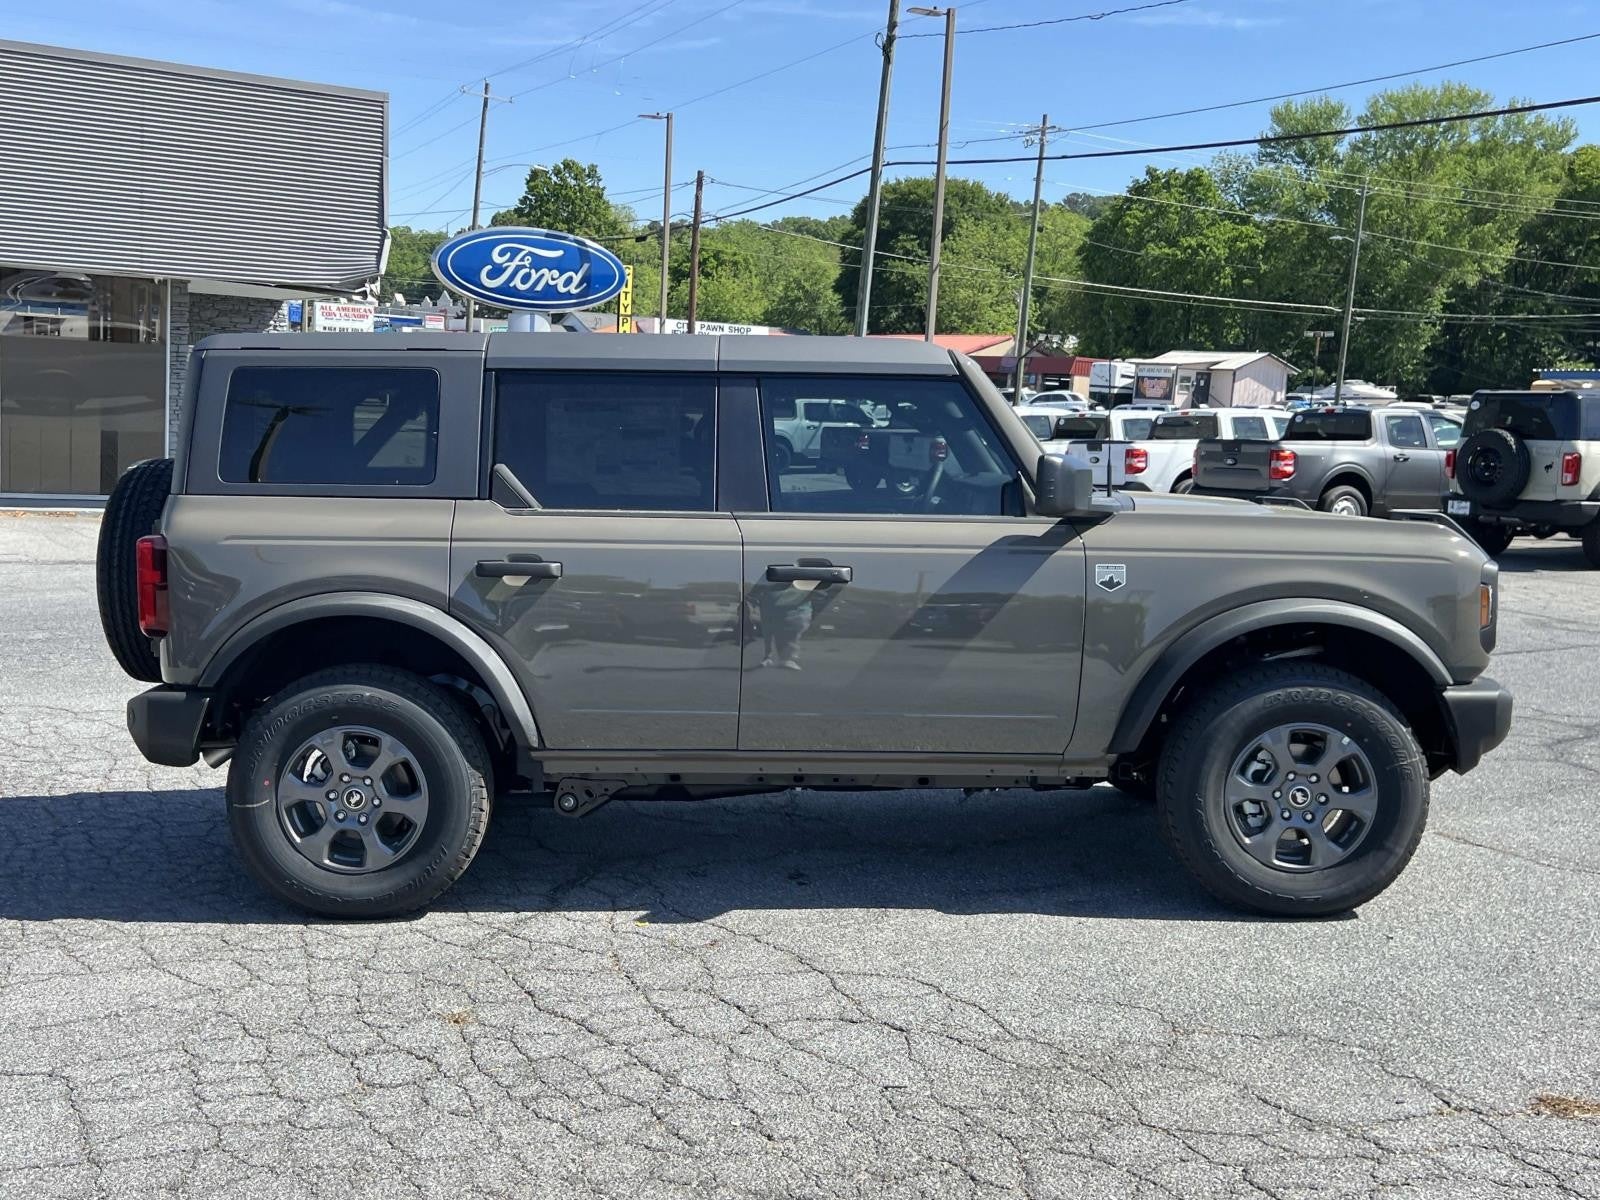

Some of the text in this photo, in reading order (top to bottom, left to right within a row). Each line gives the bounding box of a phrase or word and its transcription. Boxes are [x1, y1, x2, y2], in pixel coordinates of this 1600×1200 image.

[480, 243, 591, 295] Ford
[336, 306, 373, 314] AMERICAN
[700, 323, 724, 332] PAWN
[728, 325, 752, 334] SHOP
